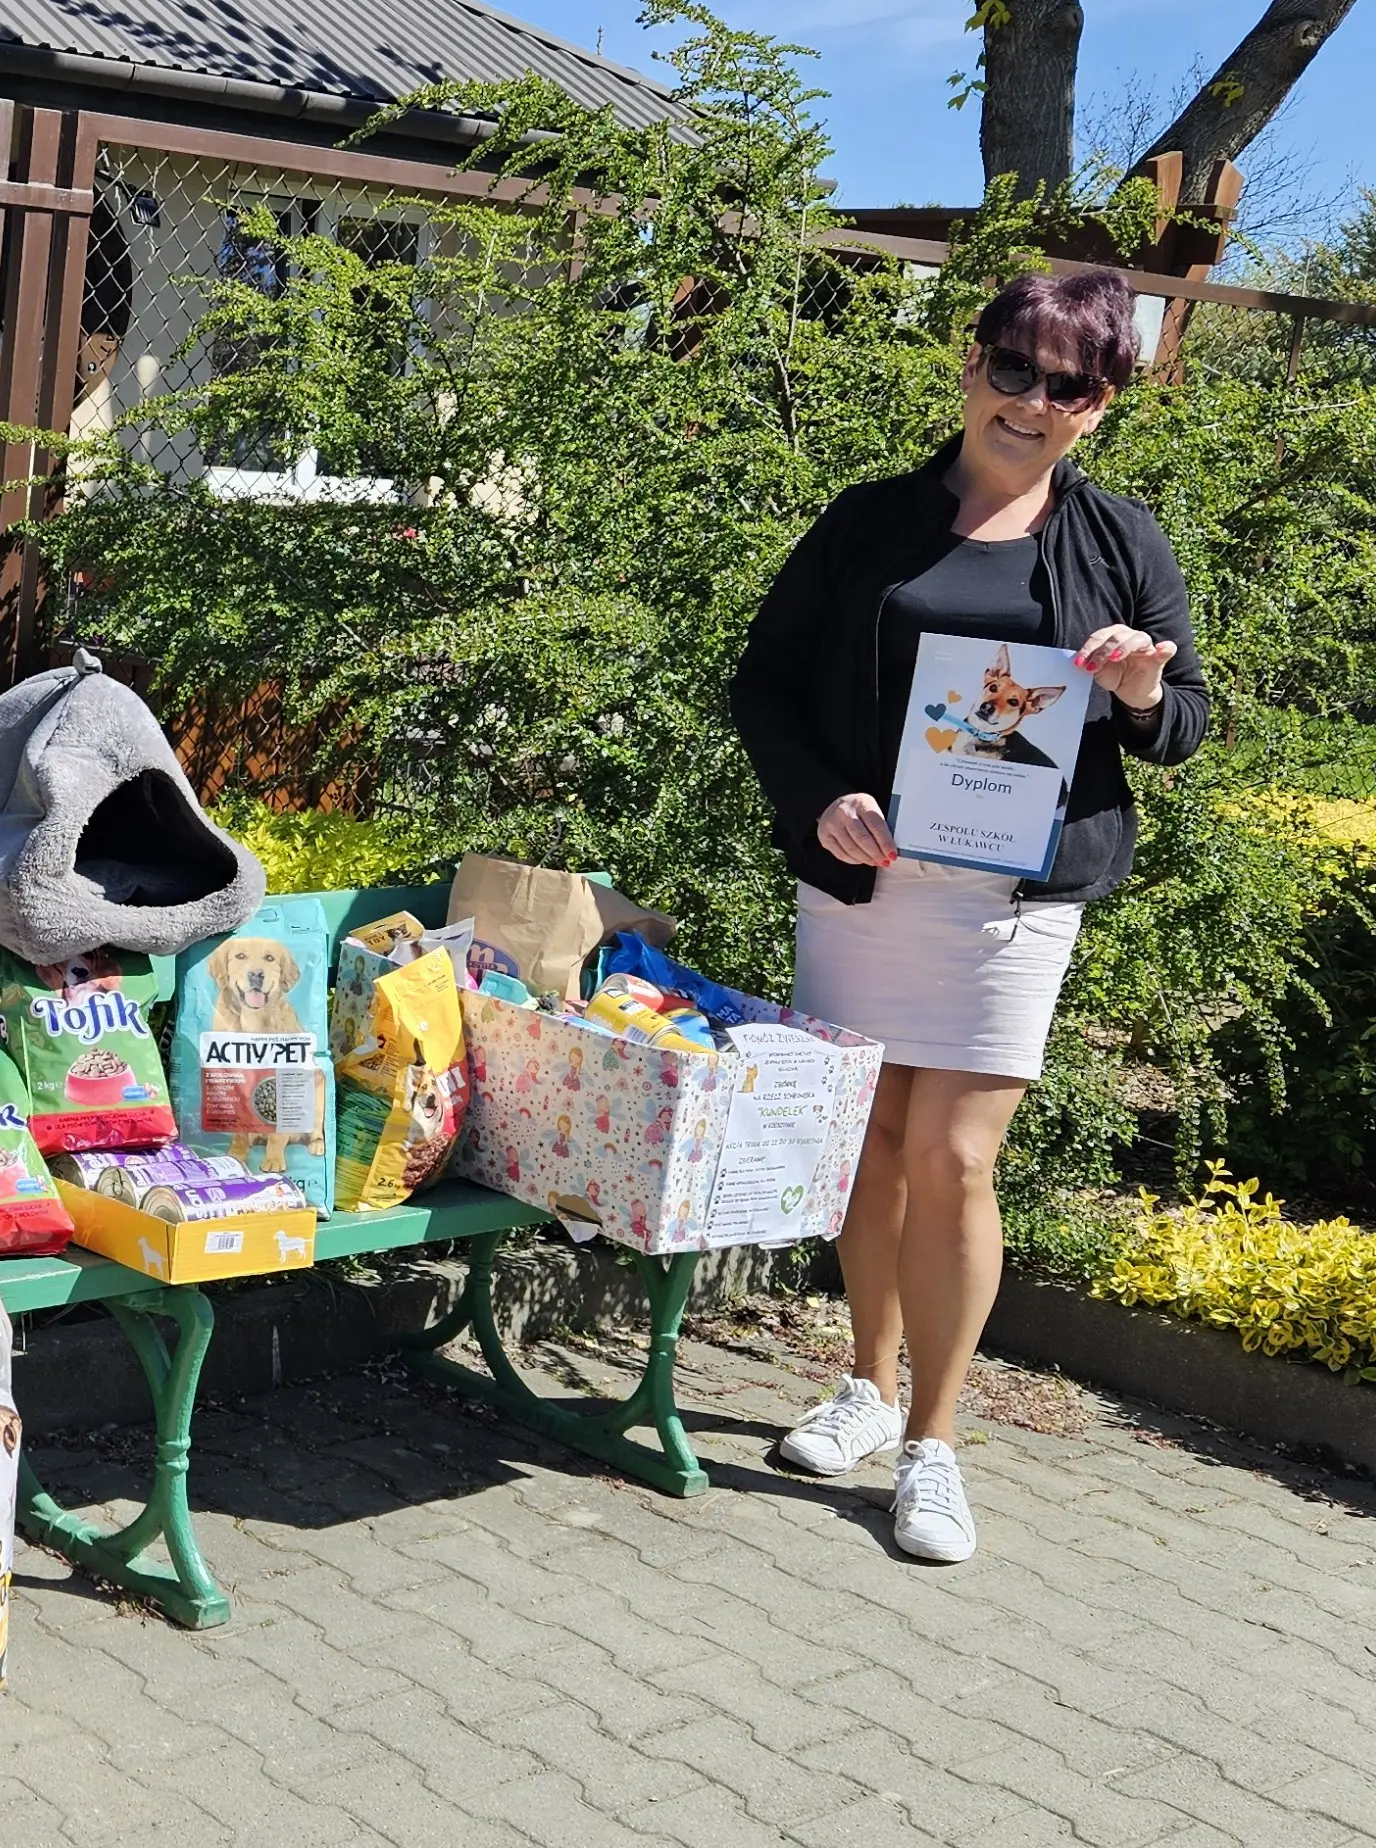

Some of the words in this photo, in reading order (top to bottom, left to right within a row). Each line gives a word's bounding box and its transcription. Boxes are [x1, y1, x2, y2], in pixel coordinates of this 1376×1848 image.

[951, 773, 1012, 795] Dyplom
[32, 991, 149, 1043] Tofik
[377, 1177, 394, 1188] 2.6
